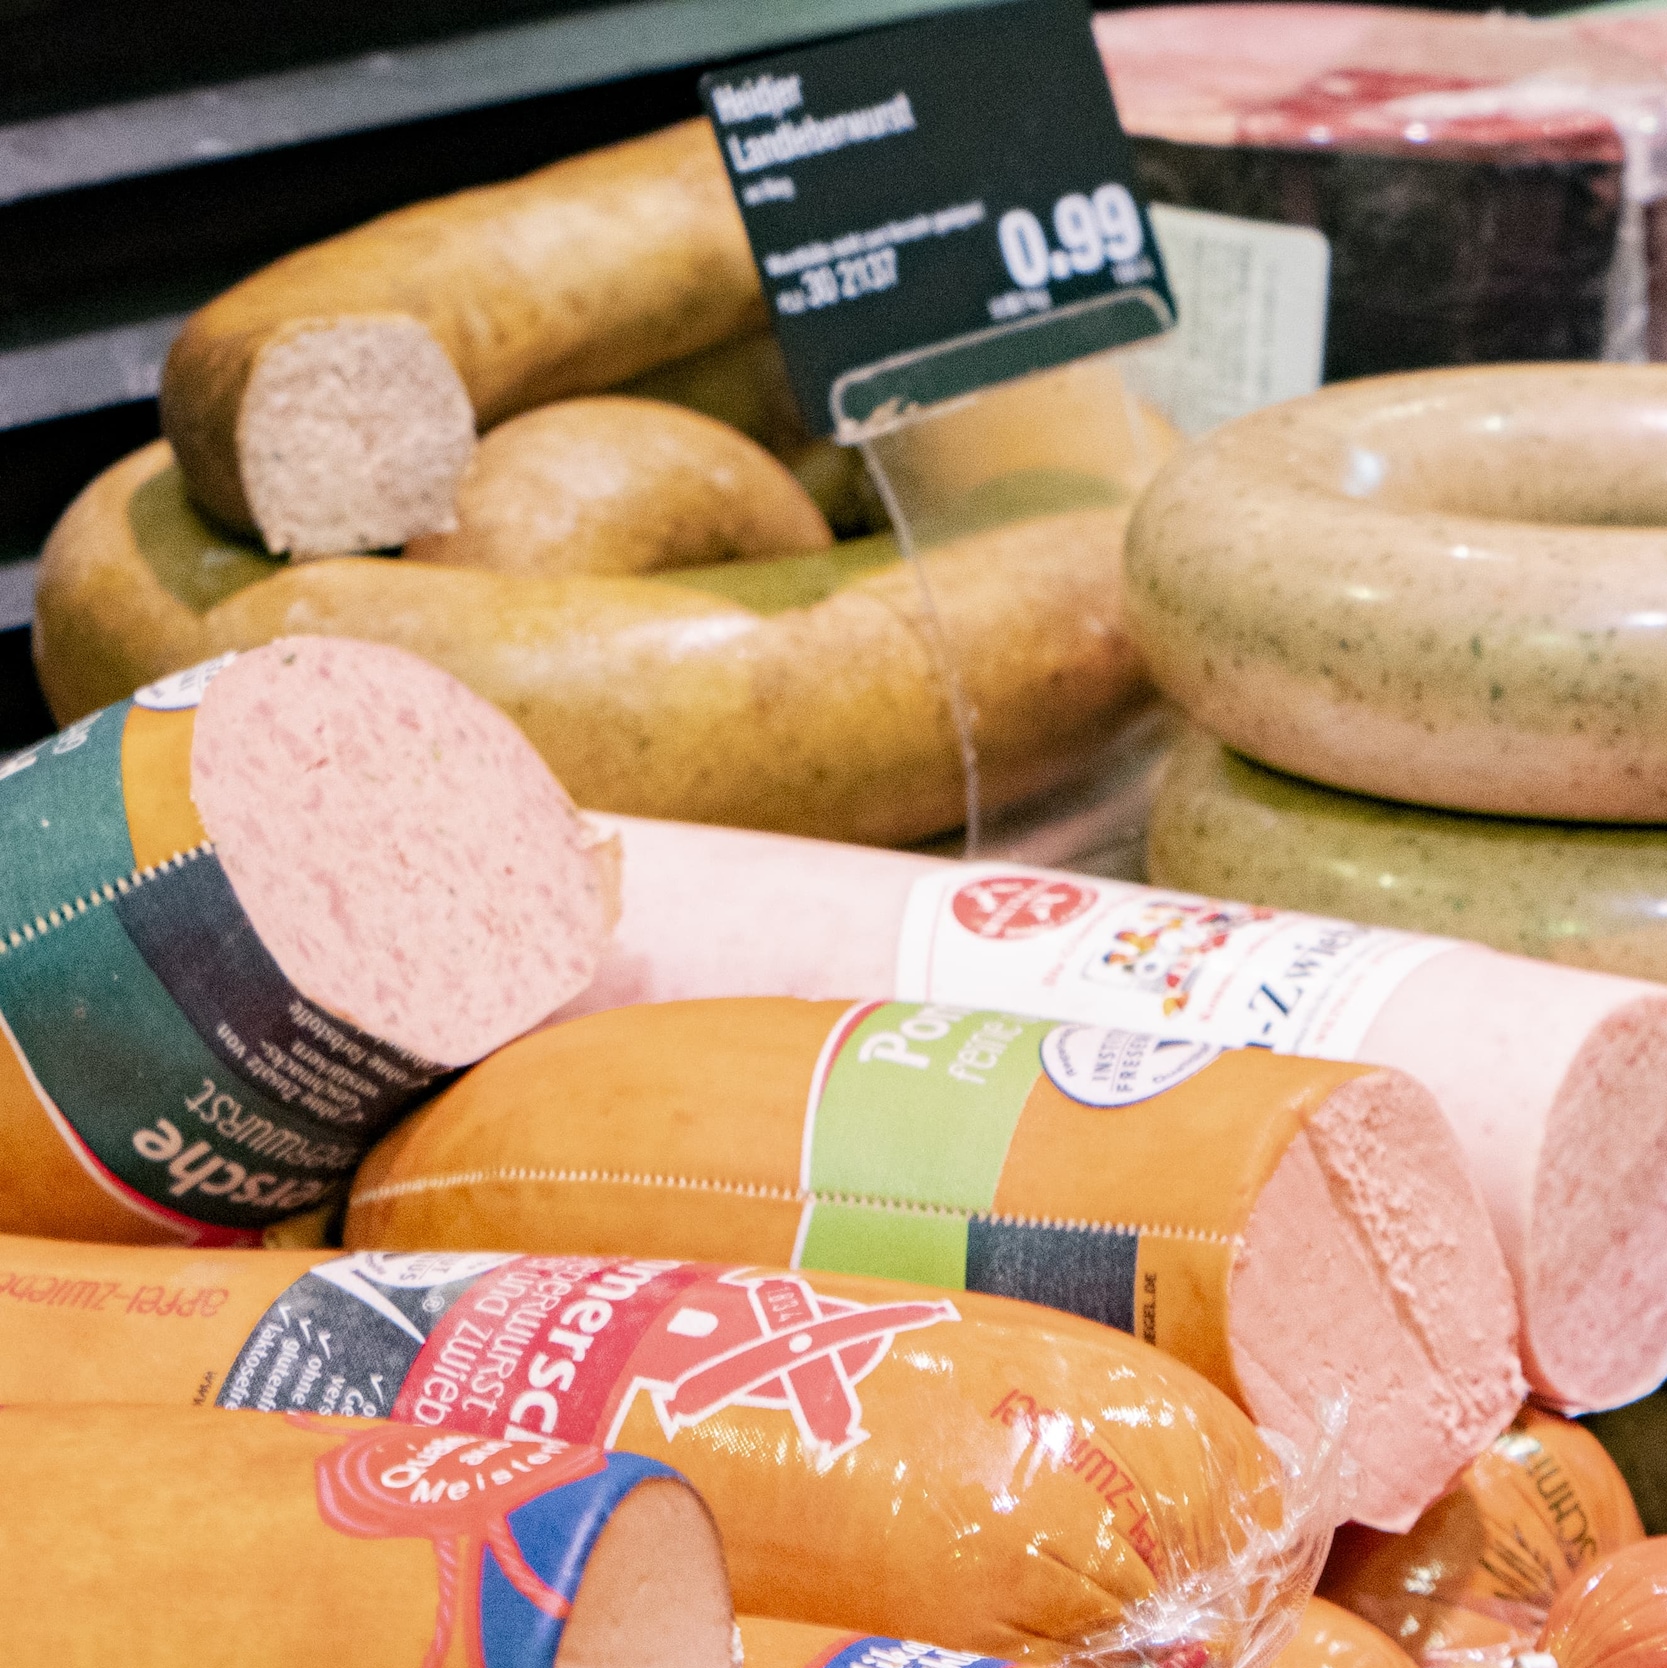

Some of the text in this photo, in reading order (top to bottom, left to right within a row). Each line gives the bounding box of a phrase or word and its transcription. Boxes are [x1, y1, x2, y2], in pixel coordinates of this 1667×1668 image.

[997, 181, 1144, 289] 0.99
[217, 1021, 247, 1059] von
[291, 1354, 313, 1406] ohne
